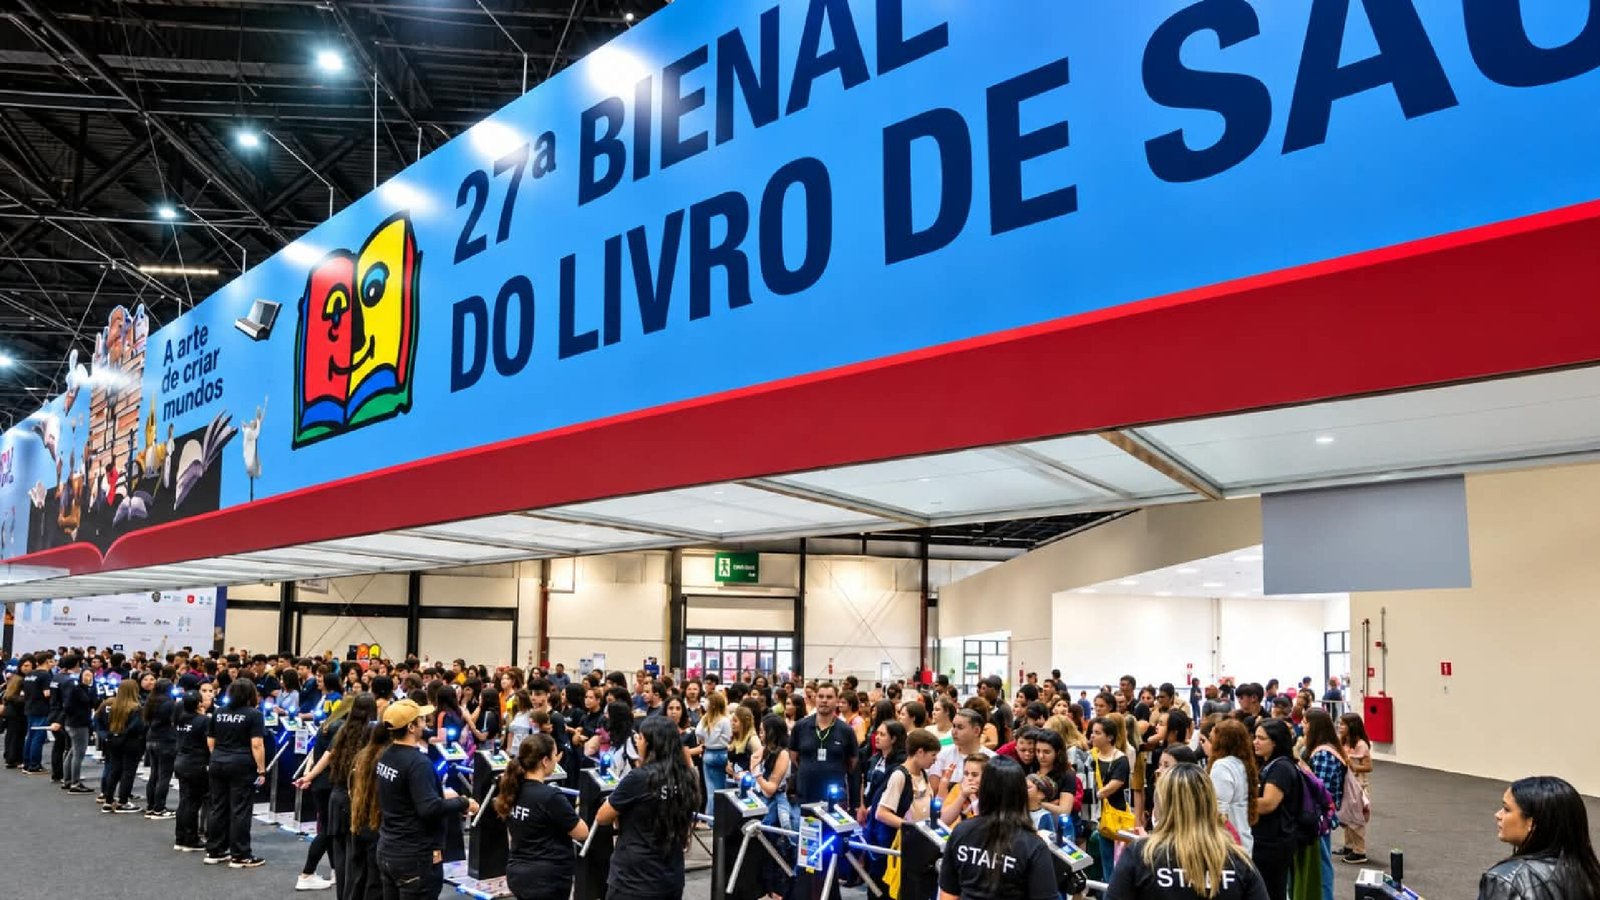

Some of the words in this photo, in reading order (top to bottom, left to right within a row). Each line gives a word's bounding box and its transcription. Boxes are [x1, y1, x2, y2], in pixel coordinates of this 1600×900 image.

[577, 0, 949, 207] BIENAL
[450, 274, 535, 394] DO
[558, 156, 833, 361] LIVRO
[883, 57, 1078, 265] DE
[163, 339, 174, 367] A
[177, 325, 208, 359] arte
[162, 366, 179, 394] de
[183, 347, 221, 384] criar
[163, 377, 223, 422] mundos
[216, 713, 246, 723] STAFF
